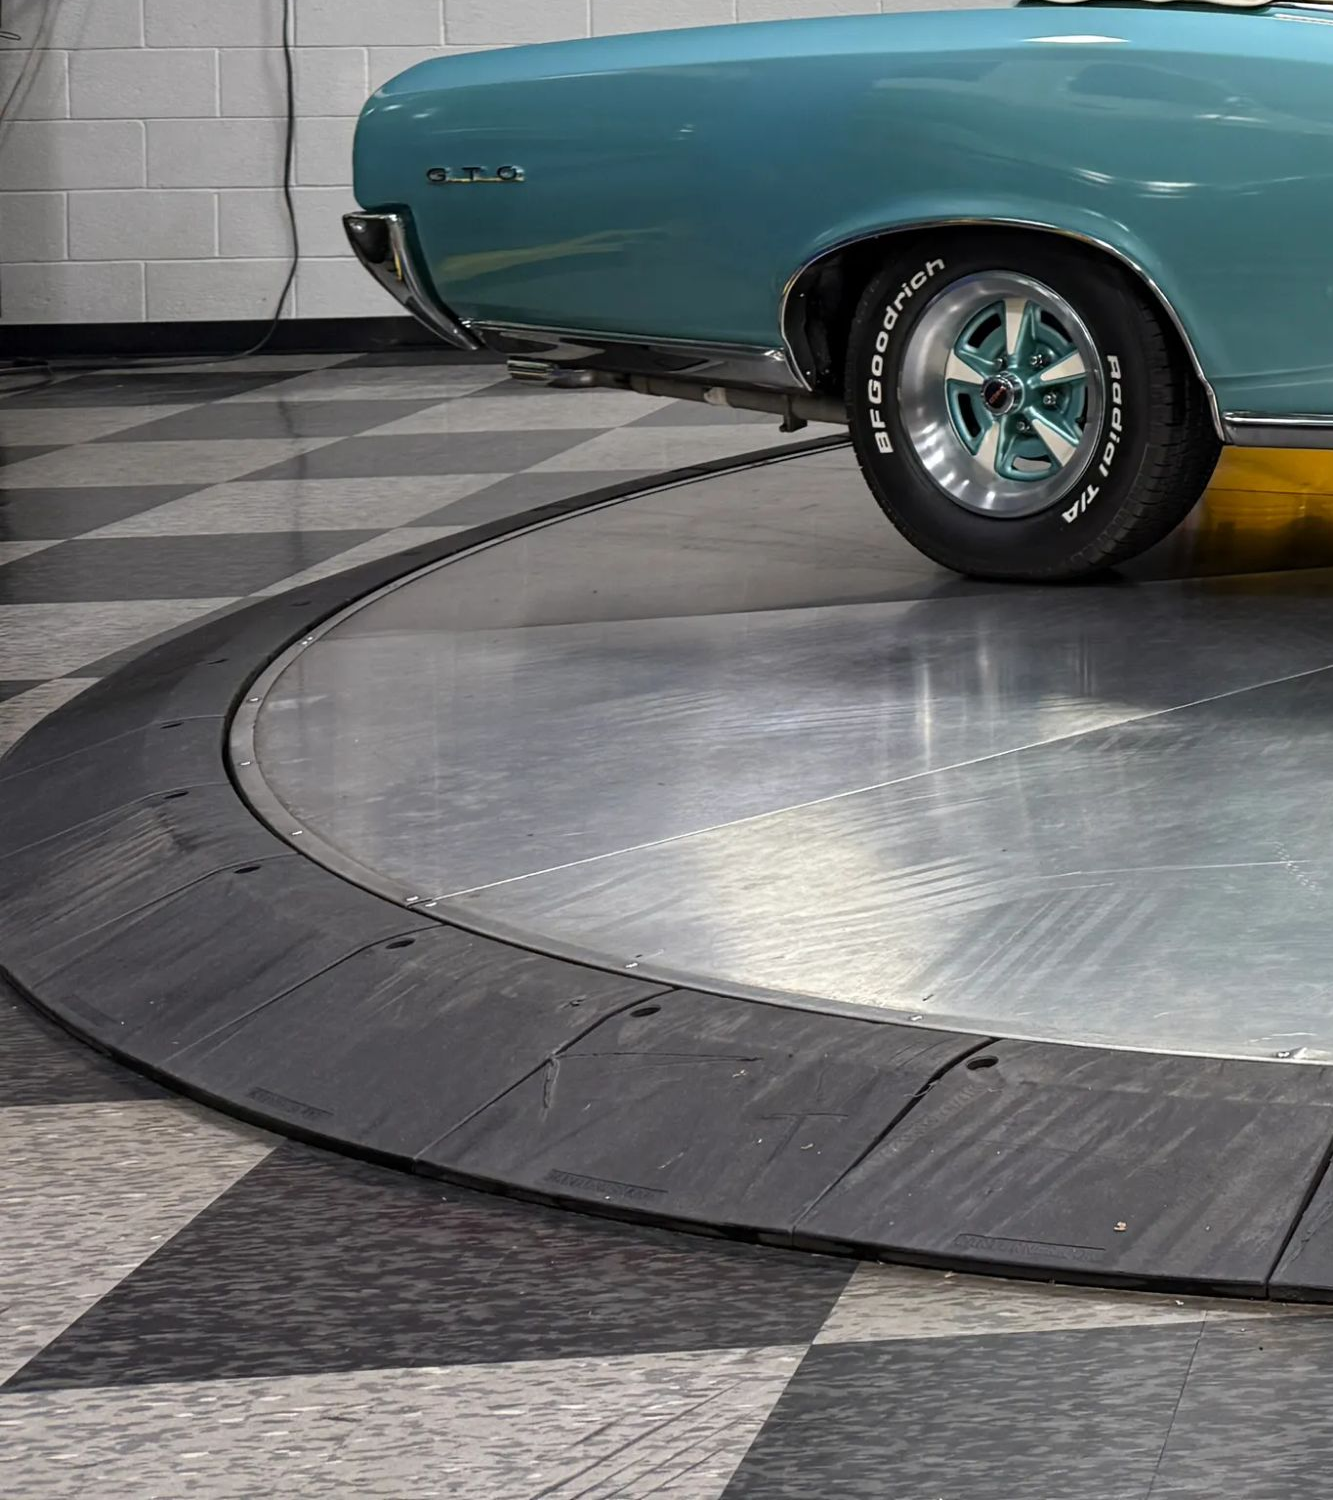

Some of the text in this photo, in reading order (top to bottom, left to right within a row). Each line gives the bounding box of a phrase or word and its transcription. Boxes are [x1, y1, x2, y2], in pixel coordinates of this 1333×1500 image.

[868, 258, 946, 454] BFGoodrich
[1061, 354, 1124, 524] Radial T/A
